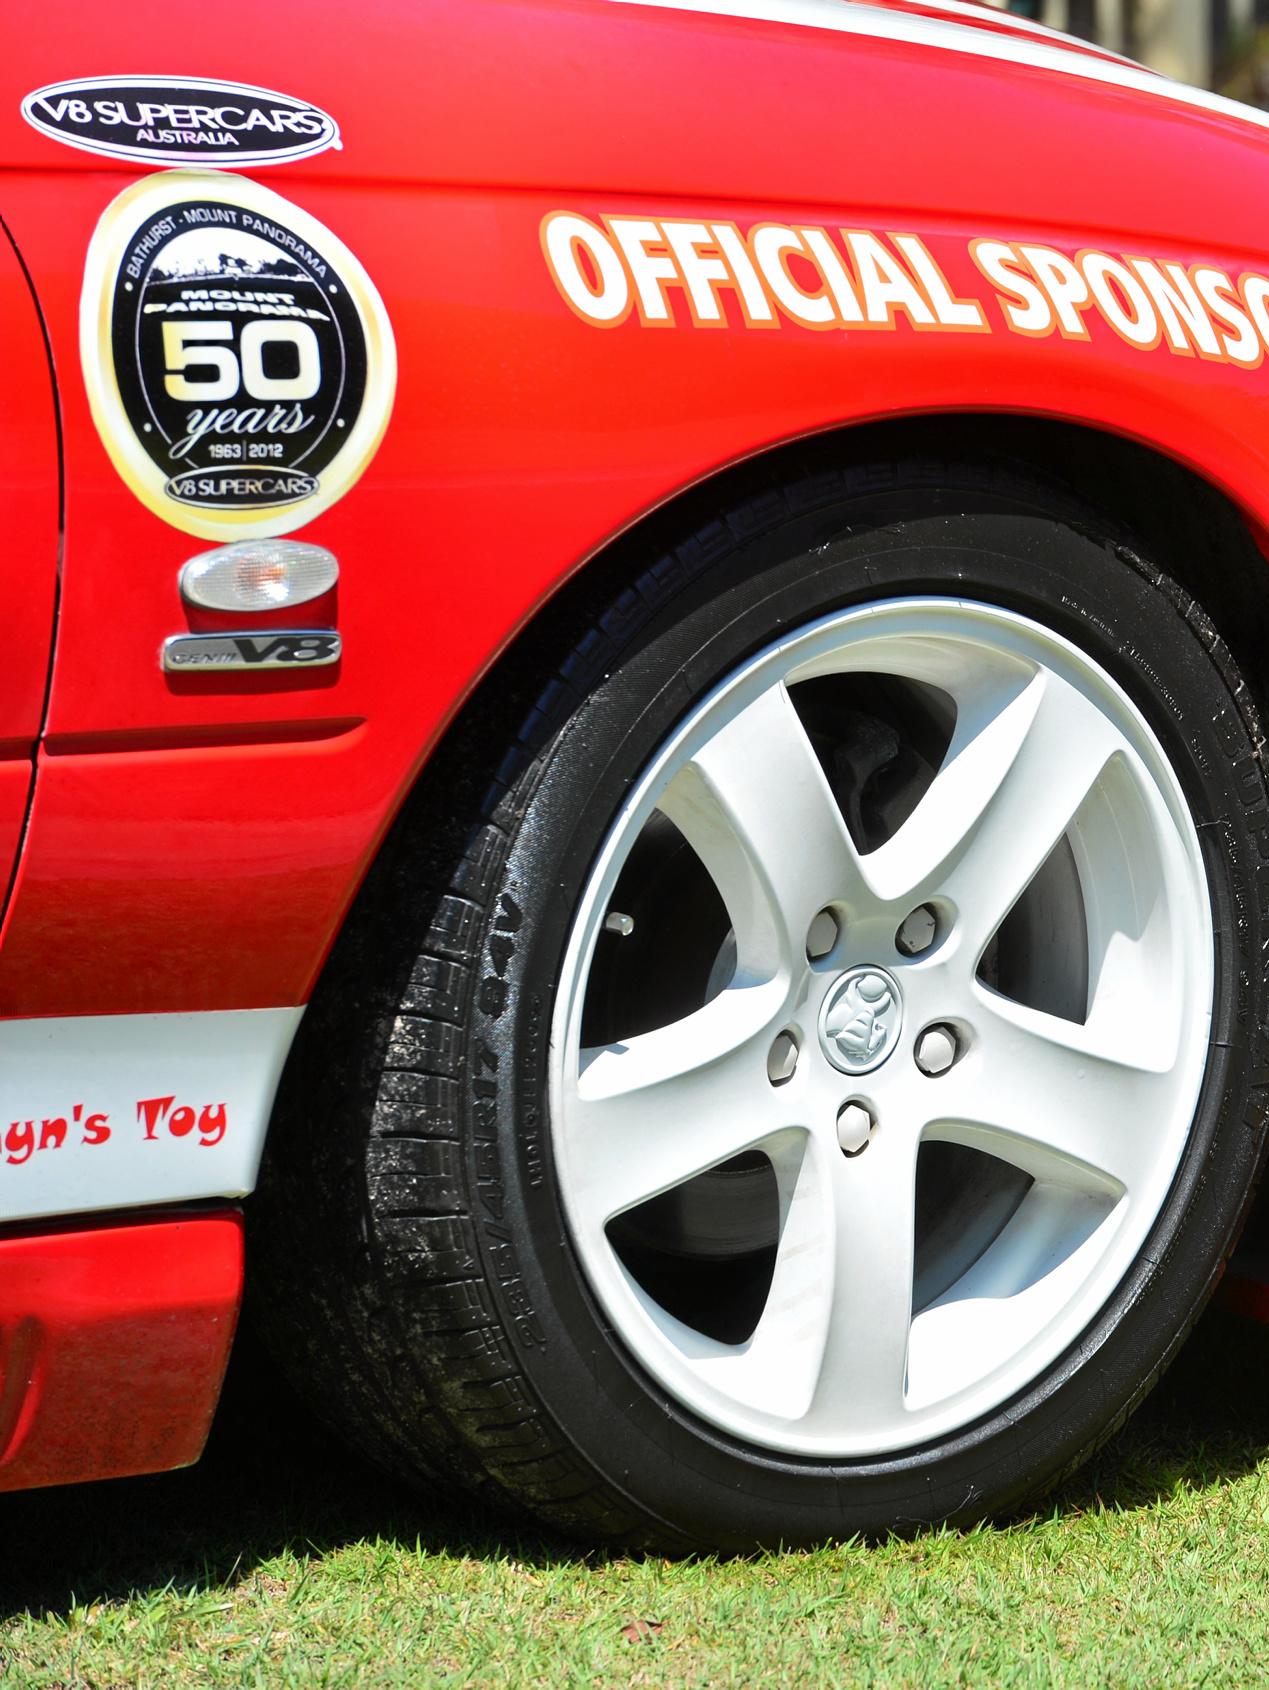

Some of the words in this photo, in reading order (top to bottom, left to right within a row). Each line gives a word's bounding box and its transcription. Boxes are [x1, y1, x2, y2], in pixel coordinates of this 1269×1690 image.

[38, 97, 92, 123] V8
[93, 100, 327, 135] SUPERCARS
[136, 128, 239, 146] AUSTRALIA
[126, 216, 177, 280] BATHURST
[183, 207, 239, 225] MOUNT
[241, 213, 328, 279] PANORAMA
[540, 207, 992, 337] OFFICIAL
[143, 303, 331, 322] PANORAMA
[180, 289, 296, 306] MOUNT
[161, 319, 321, 402] 50
[168, 402, 315, 460] years
[248, 443, 284, 459] 2012
[170, 480, 197, 497] V8
[198, 477, 316, 496] SUPERCARS
[232, 635, 339, 663] V8
[0, 1104, 111, 1165] yn's
[136, 1096, 228, 1147] Toy
